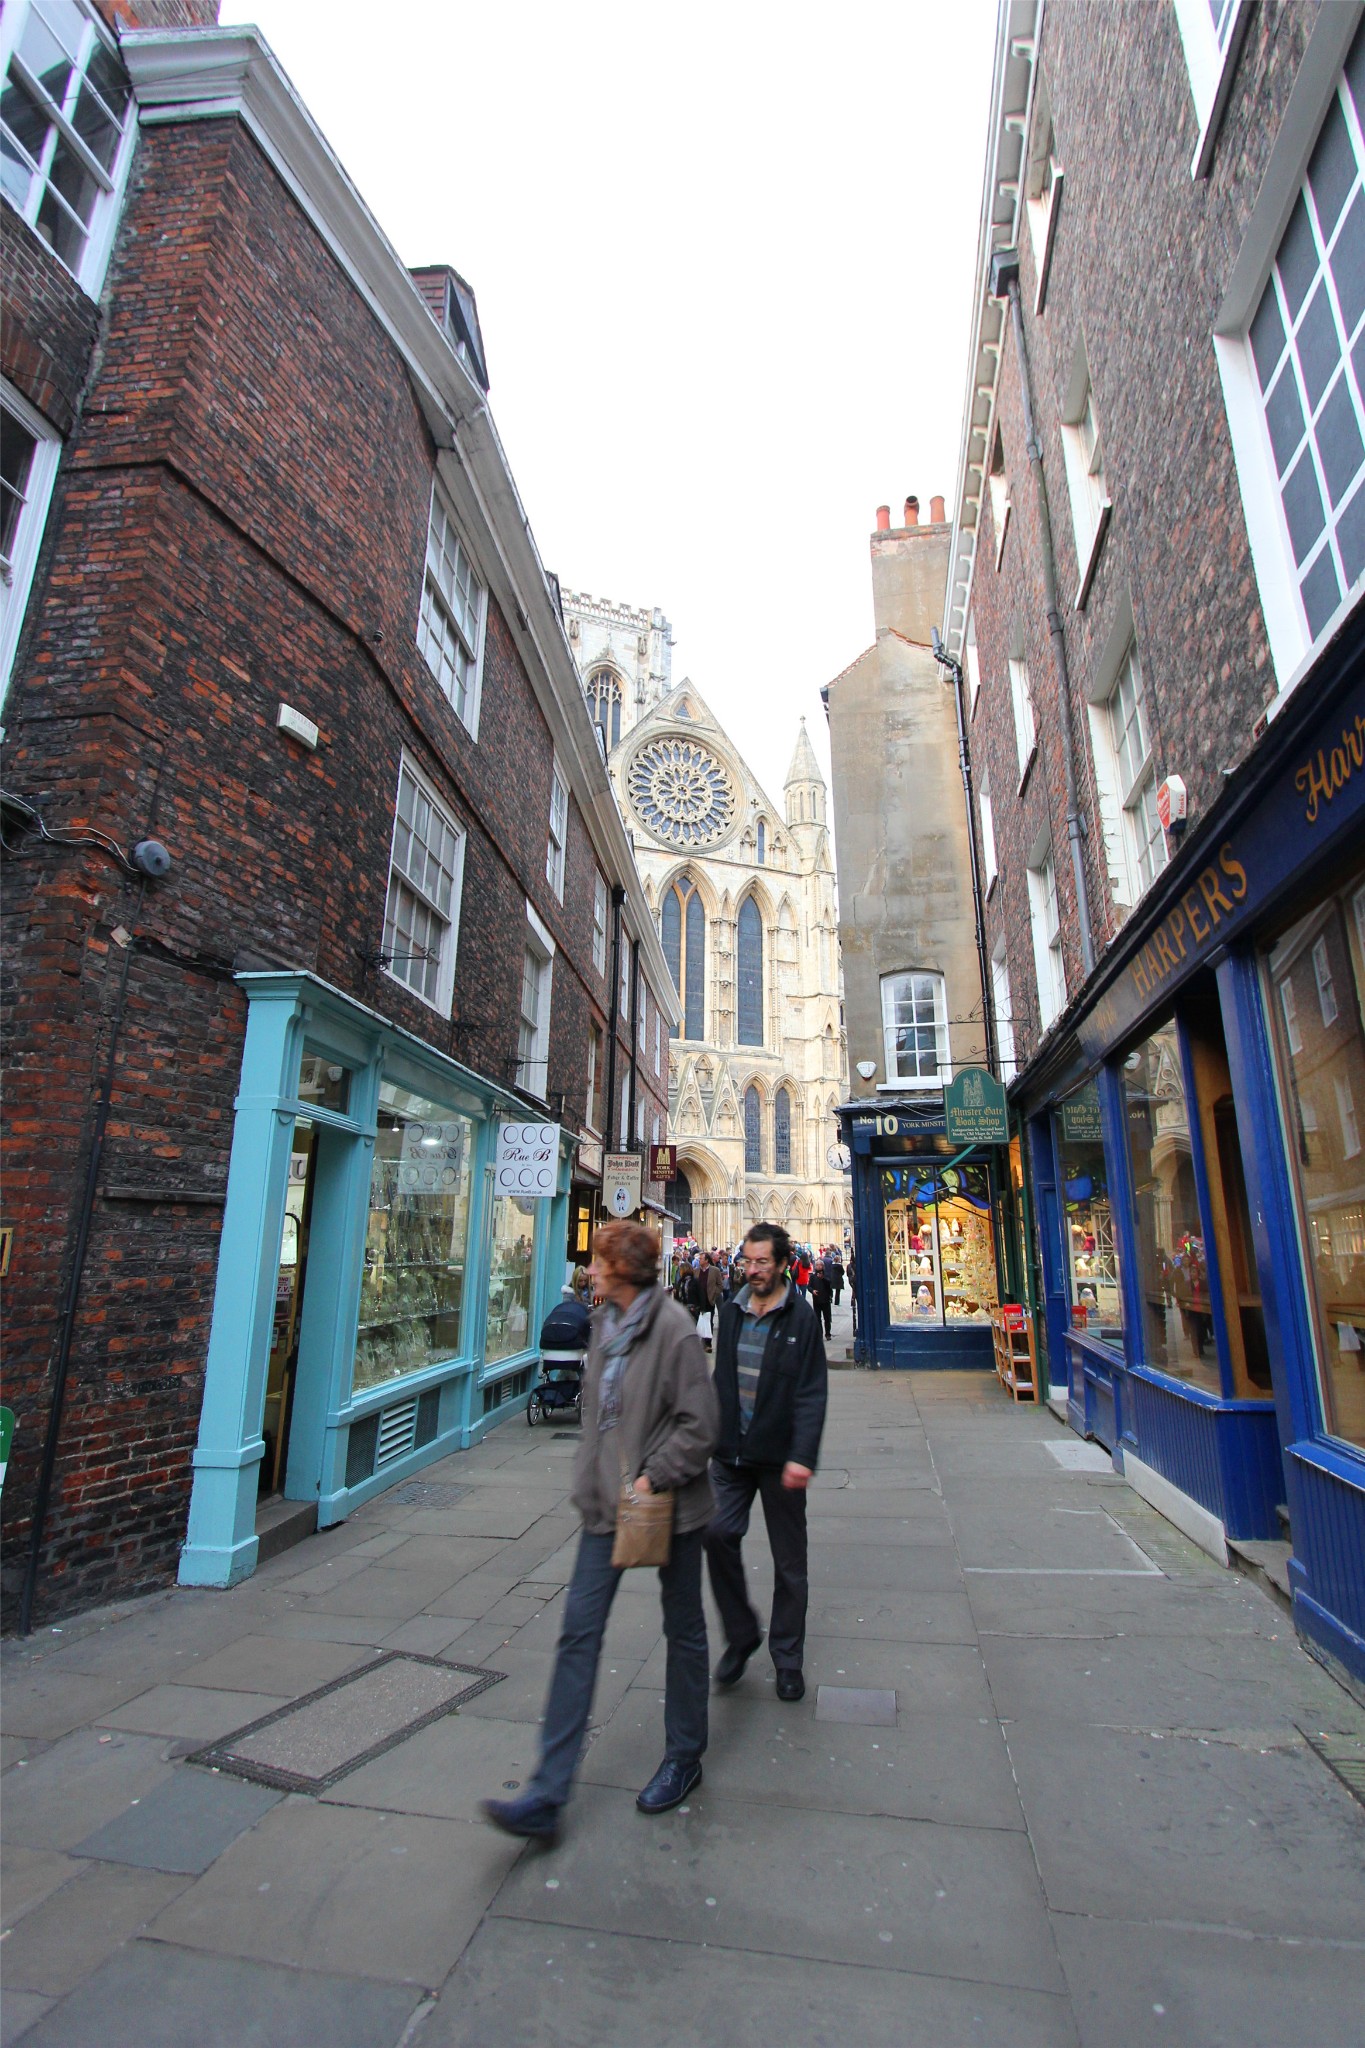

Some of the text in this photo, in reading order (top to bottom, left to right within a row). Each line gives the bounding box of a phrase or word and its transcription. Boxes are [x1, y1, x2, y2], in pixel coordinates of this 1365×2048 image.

[1128, 841, 1248, 999] HARPERS
[951, 1106, 1003, 1117] Minster Gate
[860, 1116, 874, 1124] No.
[876, 1114, 898, 1136] 10
[921, 1120, 946, 1128] MINSTE
[956, 1117, 1000, 1126] Book Shop
[502, 1147, 553, 1161] Rue B
